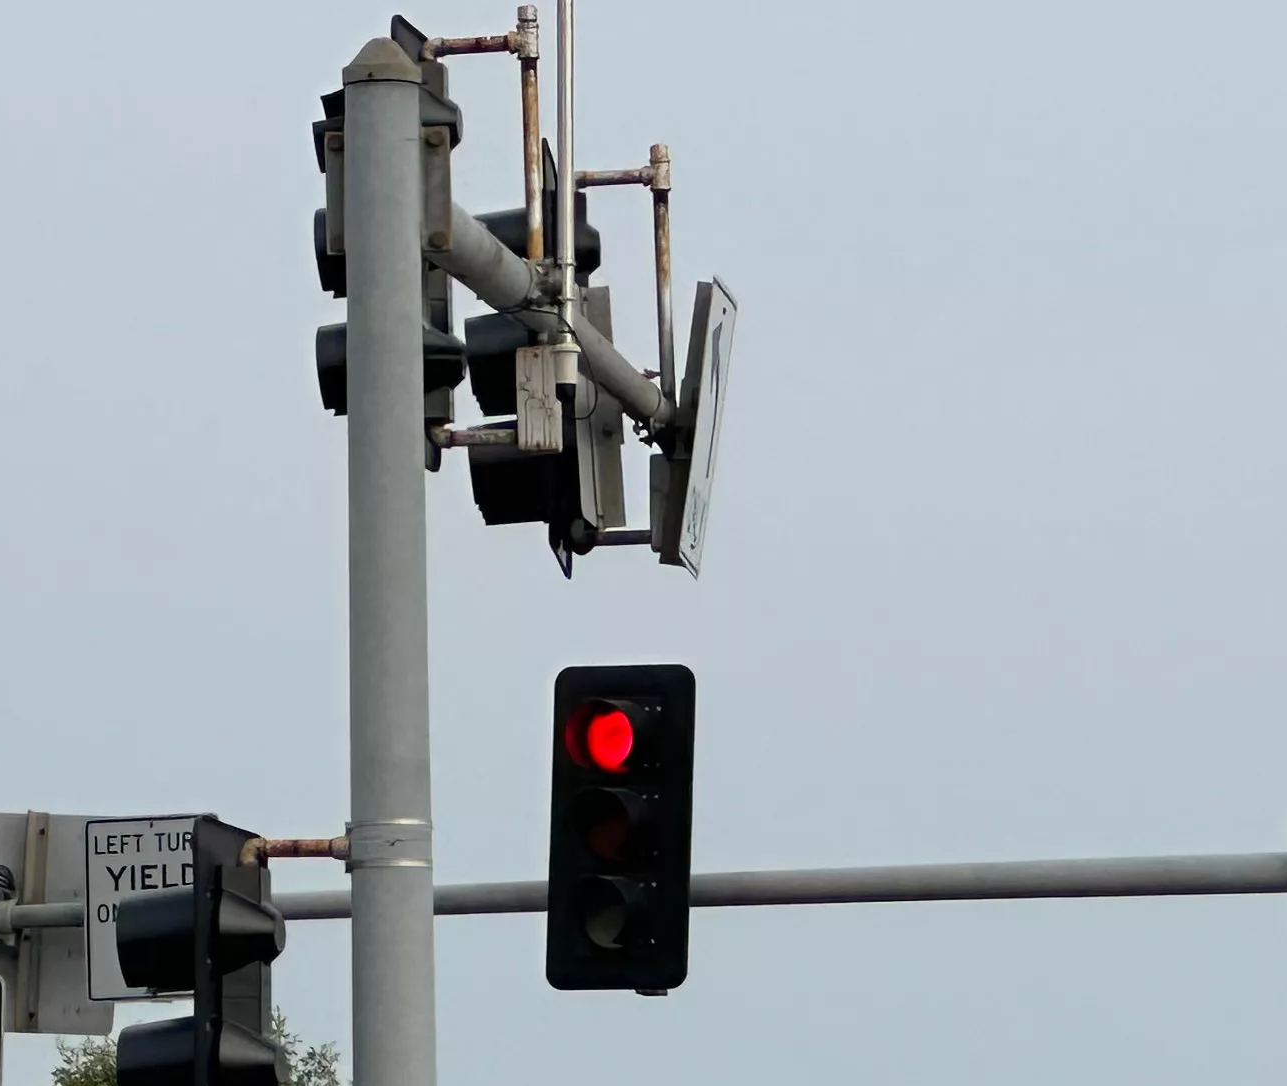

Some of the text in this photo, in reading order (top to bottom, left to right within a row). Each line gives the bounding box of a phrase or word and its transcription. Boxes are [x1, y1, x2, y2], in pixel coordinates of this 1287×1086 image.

[94, 831, 193, 855] LEFT TUR
[105, 862, 194, 892] YIELD
